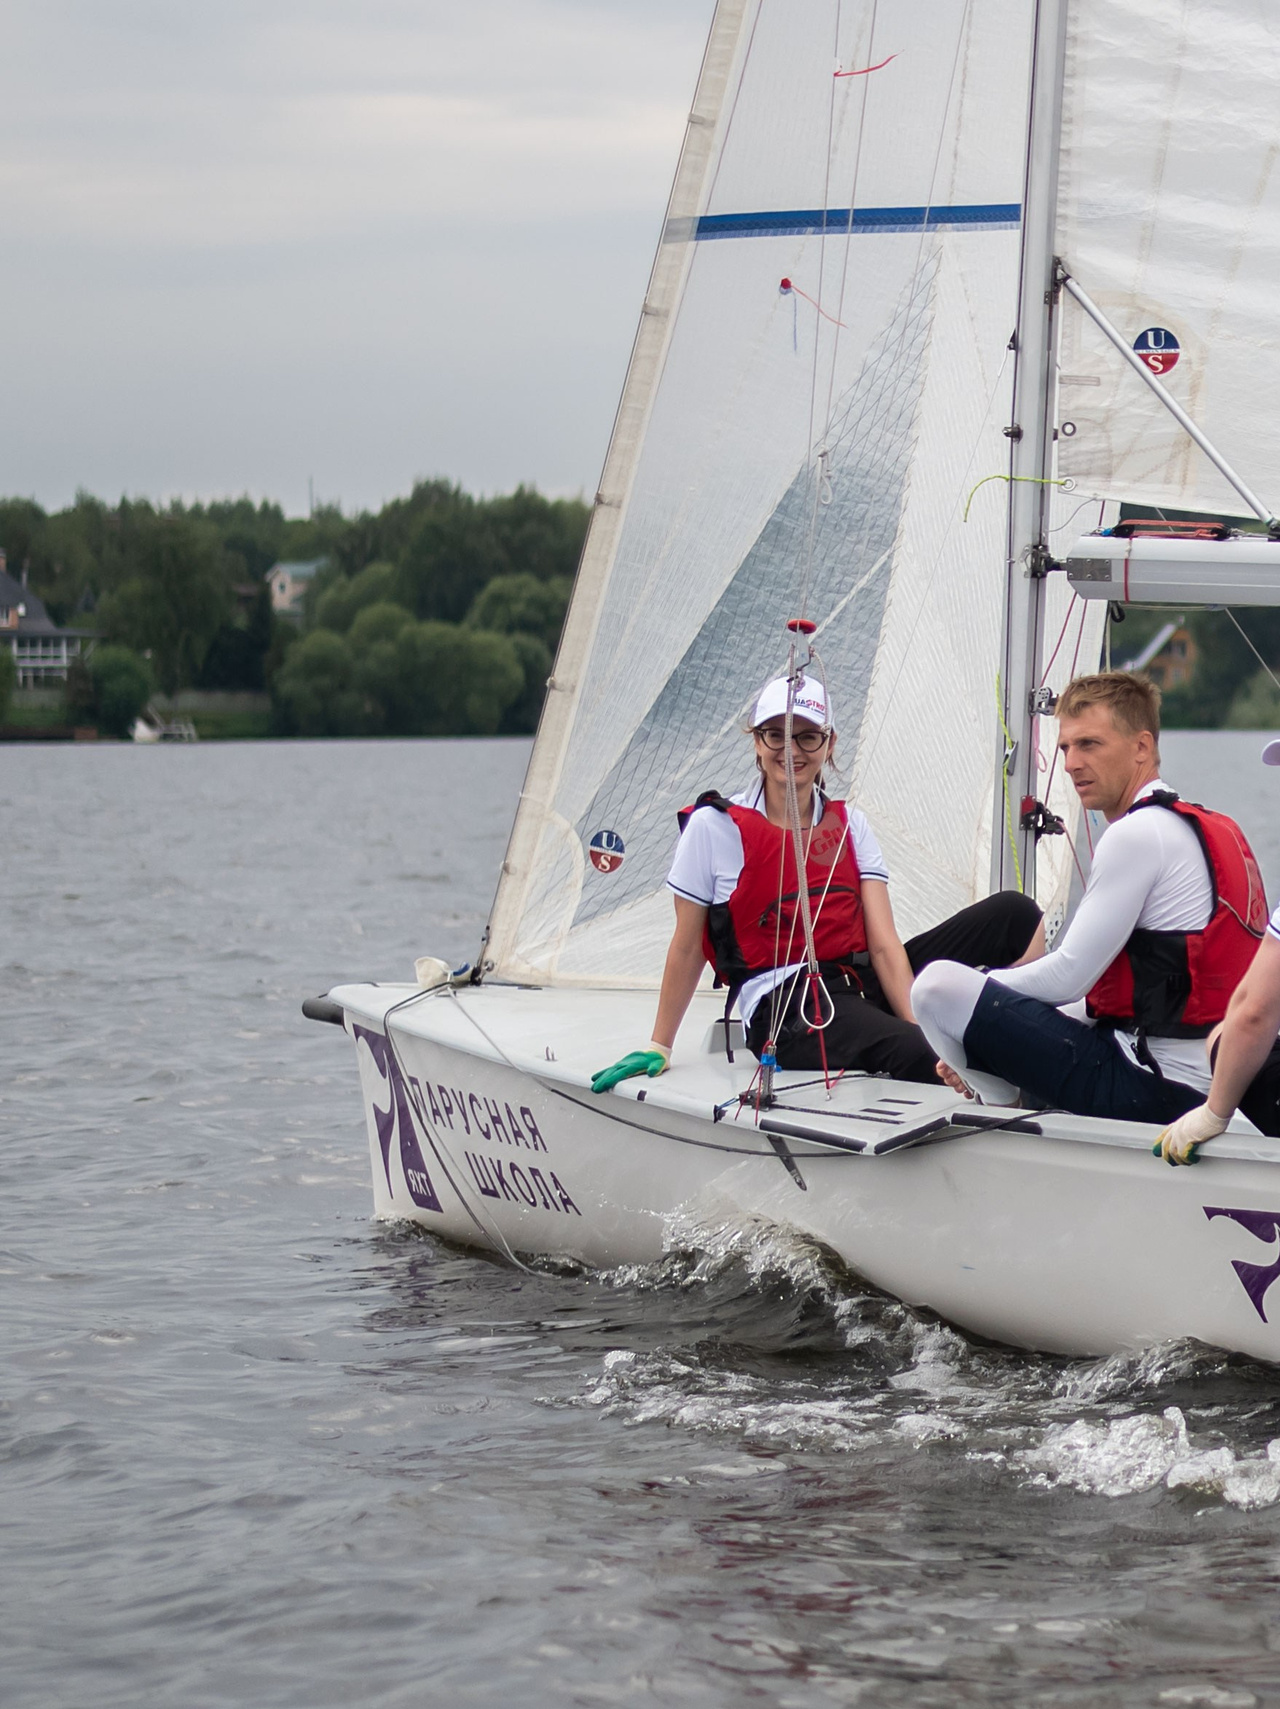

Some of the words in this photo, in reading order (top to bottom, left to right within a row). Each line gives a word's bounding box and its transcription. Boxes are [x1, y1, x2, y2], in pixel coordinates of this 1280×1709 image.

[1147, 330, 1165, 349] U
[1147, 355, 1164, 373] S
[602, 831, 617, 850] U
[598, 854, 612, 871] S
[407, 1075, 549, 1153] ПАРУСНАЯ
[407, 1168, 433, 1197] ЯХТ
[465, 1151, 582, 1216] ШКОЛА
